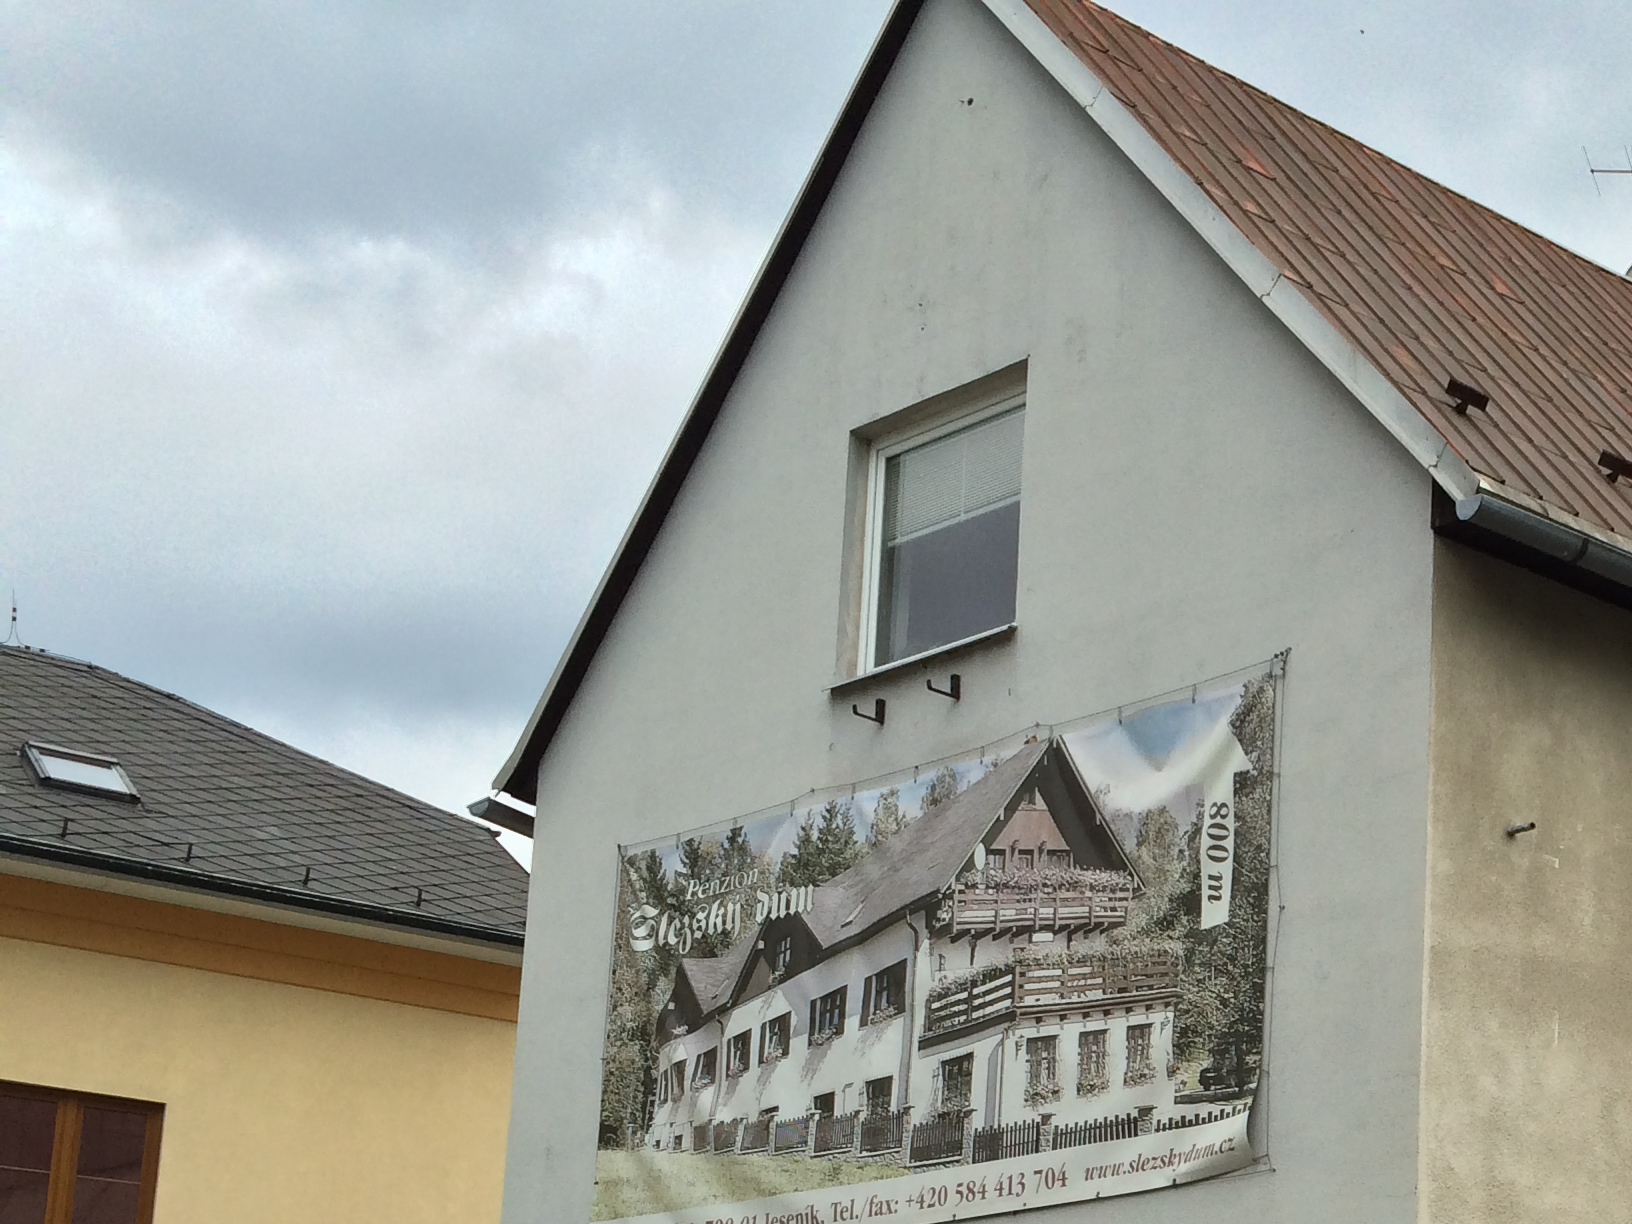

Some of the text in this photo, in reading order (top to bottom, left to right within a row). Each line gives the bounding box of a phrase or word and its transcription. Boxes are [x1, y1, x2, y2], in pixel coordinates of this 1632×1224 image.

[1206, 802, 1230, 863] 800
[905, 1185, 949, 1211] +420
[955, 1176, 988, 1207] 584
[994, 1169, 1026, 1198] 413
[1033, 1162, 1069, 1194] 704
[1084, 1136, 1236, 1182] www.slezskydum.cz
